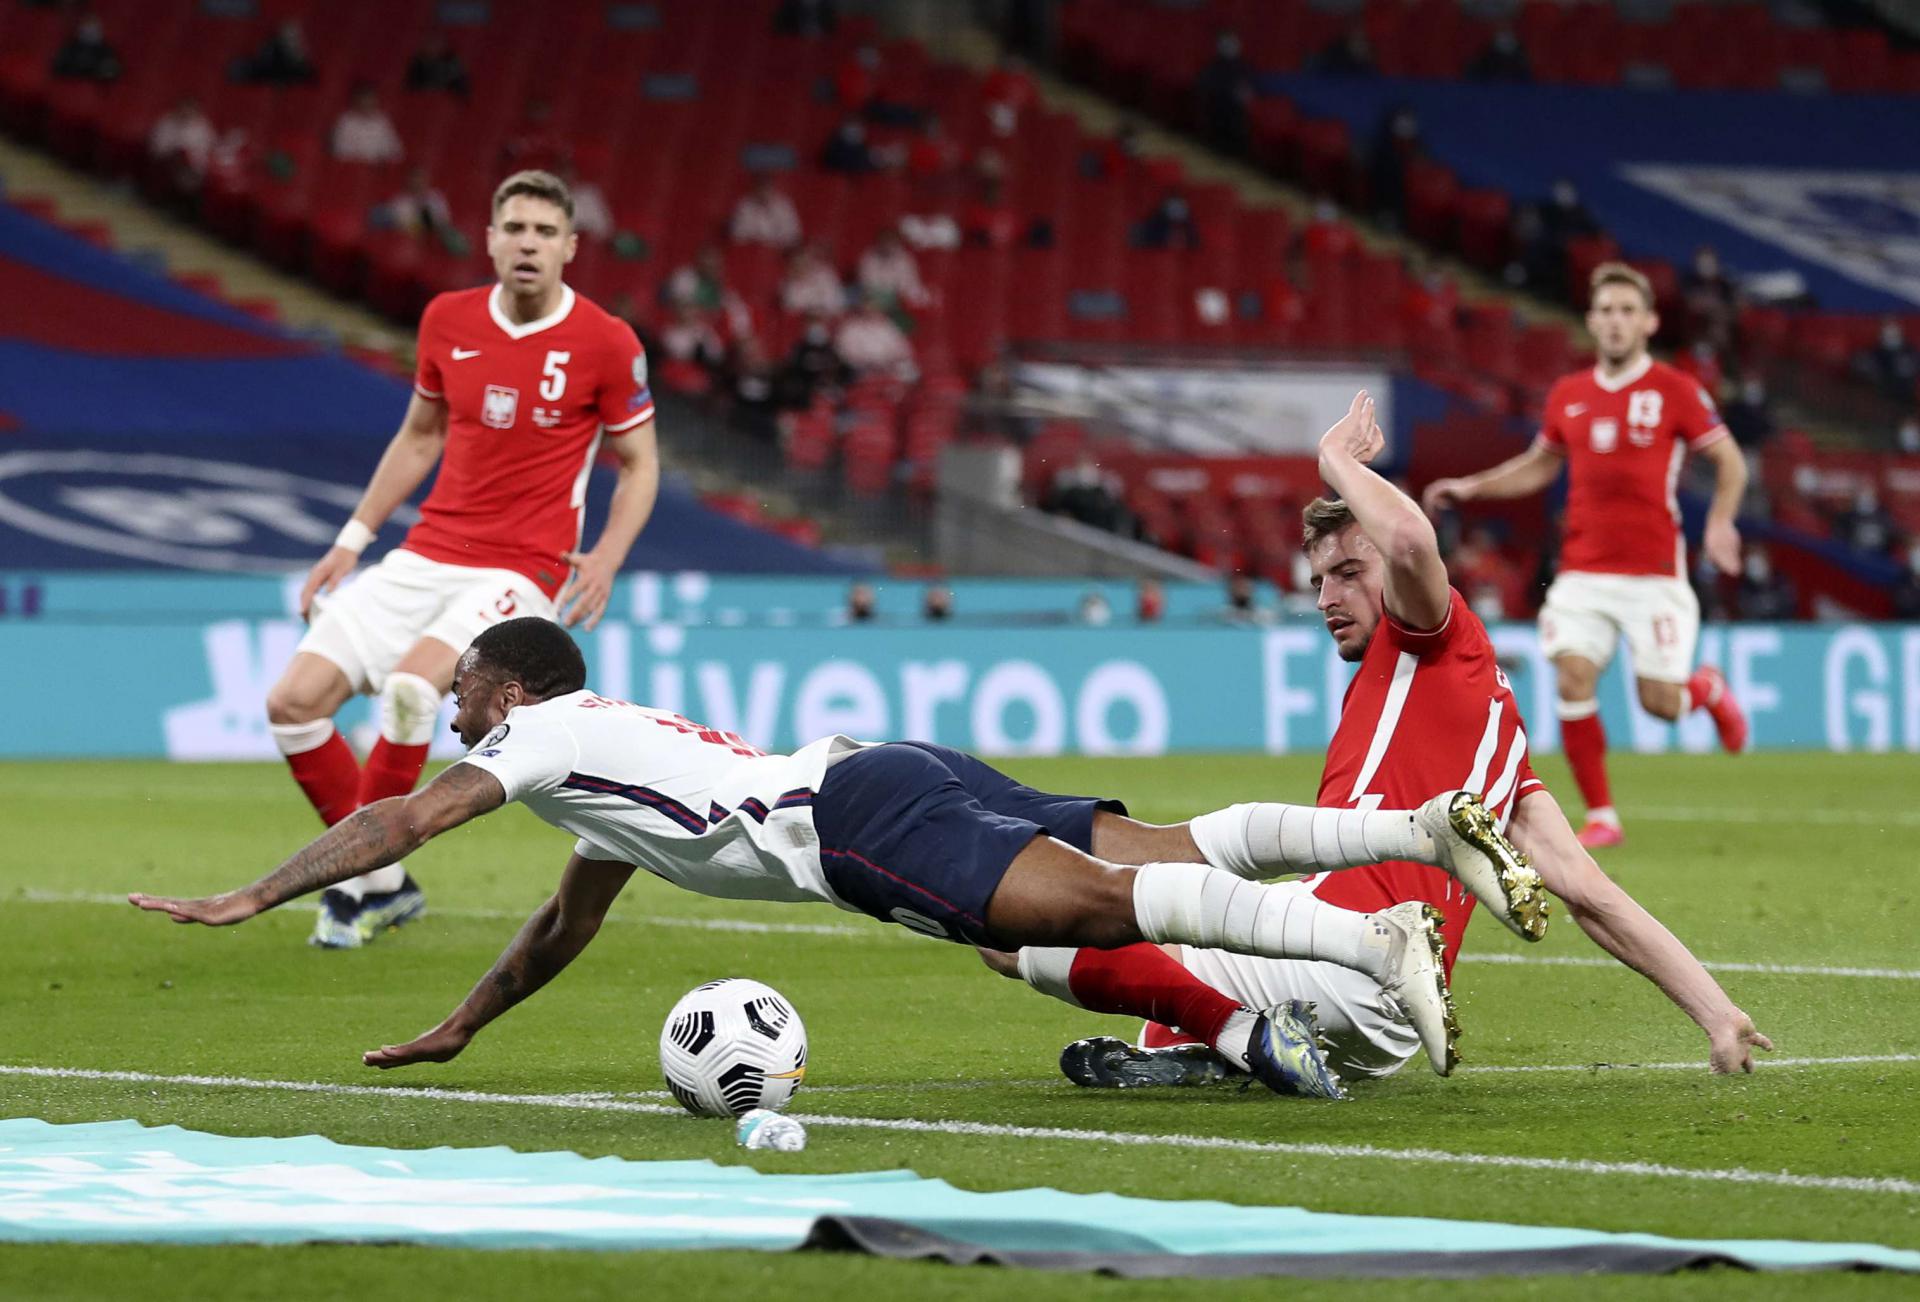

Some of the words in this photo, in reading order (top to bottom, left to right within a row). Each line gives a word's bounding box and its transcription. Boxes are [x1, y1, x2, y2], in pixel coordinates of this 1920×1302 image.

[539, 350, 571, 402] 5
[1628, 389, 1664, 428] 13
[435, 622, 1171, 758] liveroo
